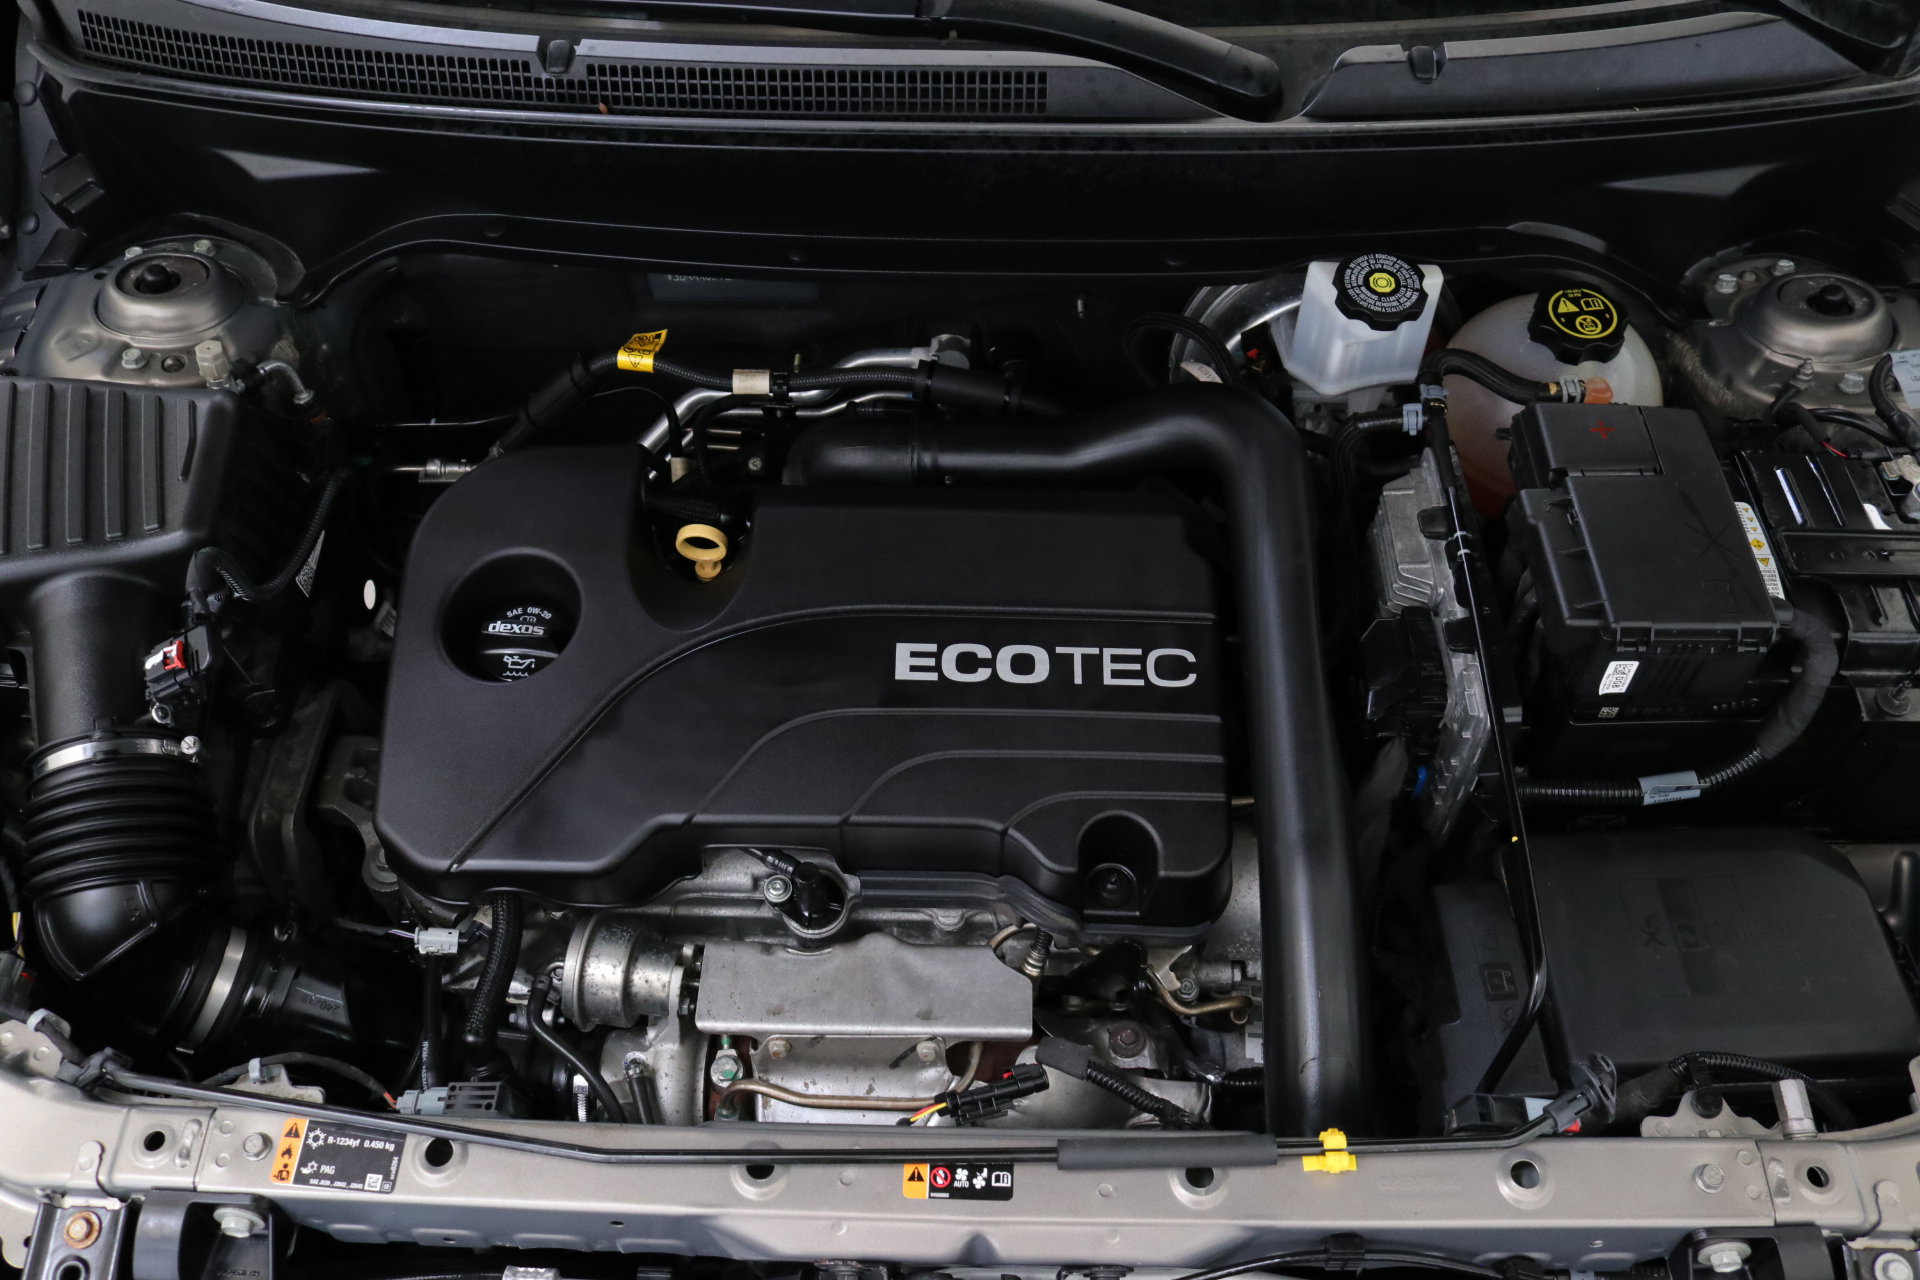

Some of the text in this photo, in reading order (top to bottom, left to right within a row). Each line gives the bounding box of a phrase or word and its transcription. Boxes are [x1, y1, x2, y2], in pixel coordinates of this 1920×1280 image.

[506, 606, 552, 620] SAE 0W-20
[488, 620, 545, 636] dexos
[895, 643, 1197, 687] ECOTEC
[327, 1136, 395, 1152] R-1234yf 0.450 kg
[320, 1164, 336, 1175] PAG
